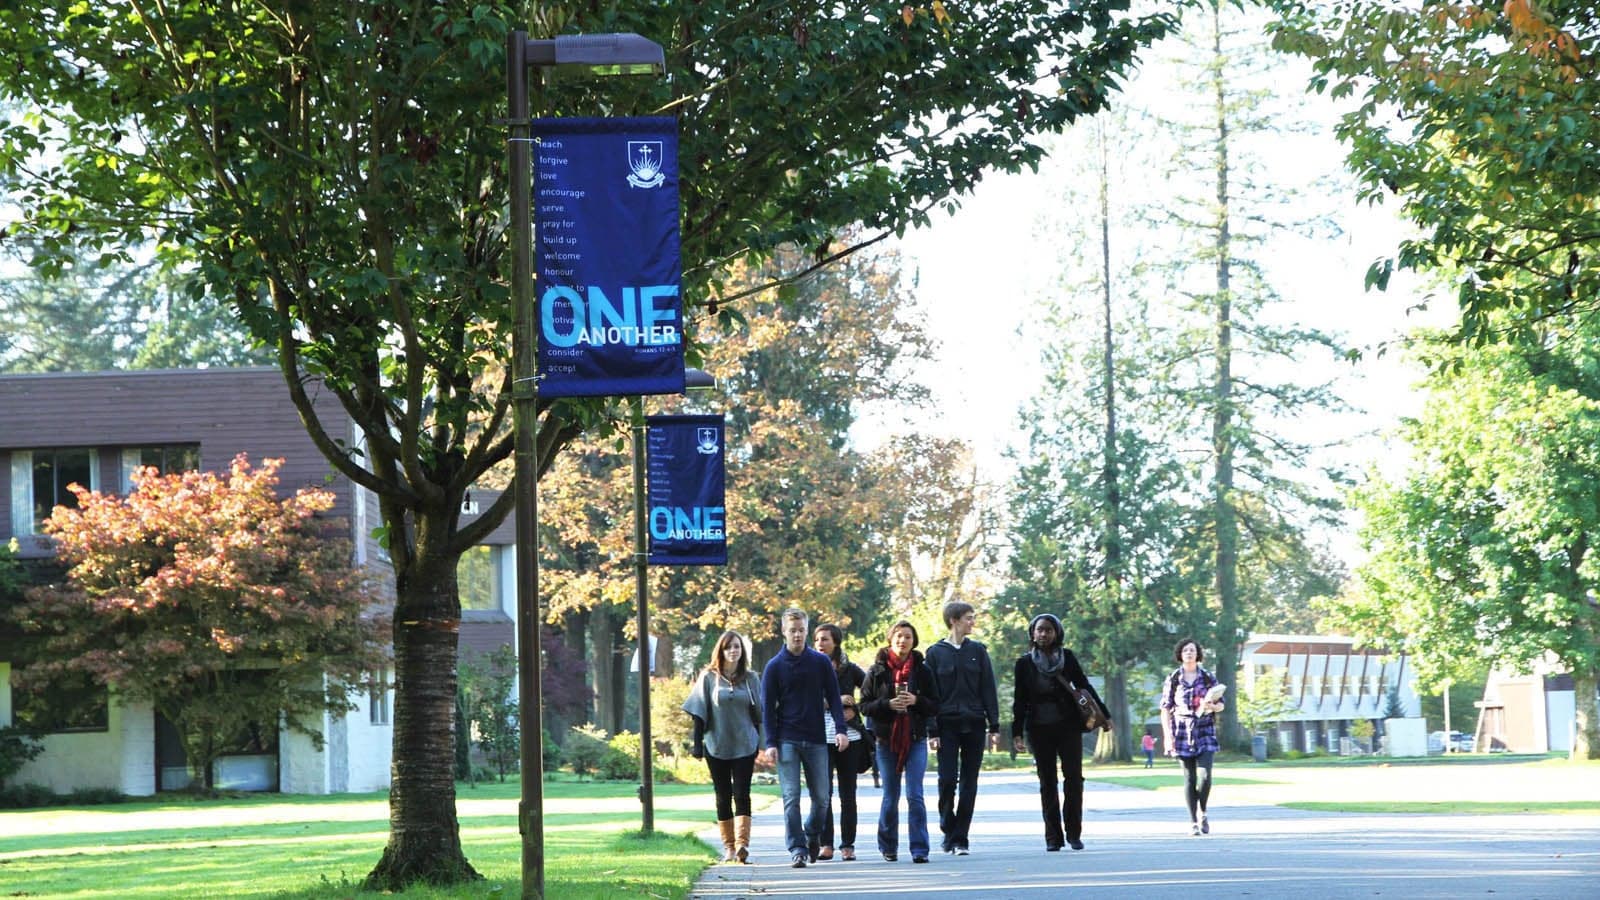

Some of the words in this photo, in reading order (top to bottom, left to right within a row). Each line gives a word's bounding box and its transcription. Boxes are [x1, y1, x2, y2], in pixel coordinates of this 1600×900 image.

[539, 156, 568, 166] forgive
[540, 172, 557, 180] love
[541, 189, 585, 199] encourage
[542, 221, 560, 229] pray
[562, 220, 575, 228] for
[543, 235, 564, 244] build
[566, 237, 577, 245] up
[544, 252, 581, 260] welcome
[545, 268, 574, 276] honour
[576, 284, 585, 292] to
[541, 285, 681, 347] ONE
[577, 326, 676, 344] ANOTHER
[547, 348, 584, 357] consider
[548, 364, 576, 374] accept
[649, 506, 725, 540] ONE
[668, 528, 723, 540] ANOTHER
